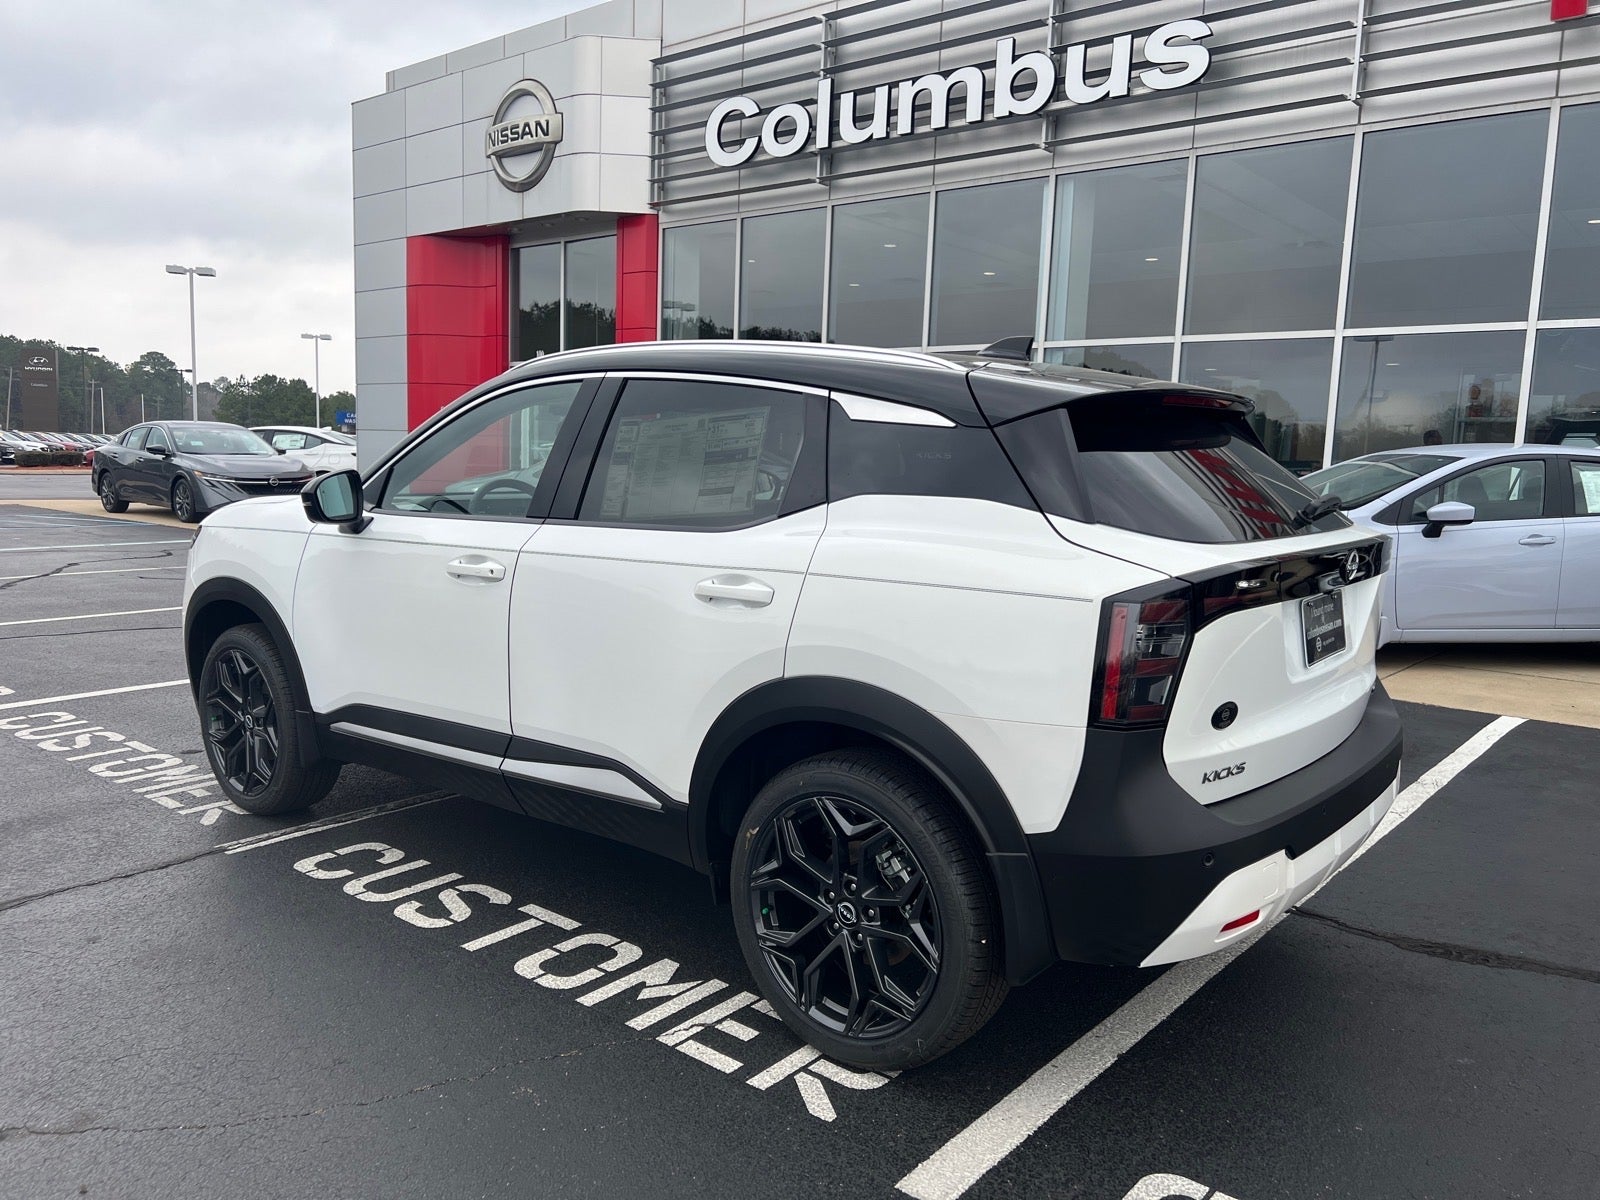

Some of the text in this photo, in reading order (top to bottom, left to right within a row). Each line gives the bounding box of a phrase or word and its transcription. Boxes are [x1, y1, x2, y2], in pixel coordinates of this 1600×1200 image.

[488, 119, 550, 150] NISSAN
[704, 19, 1214, 167] Columbus
[1201, 761, 1247, 785] KICKS
[293, 842, 902, 1123] CUSTOMER
